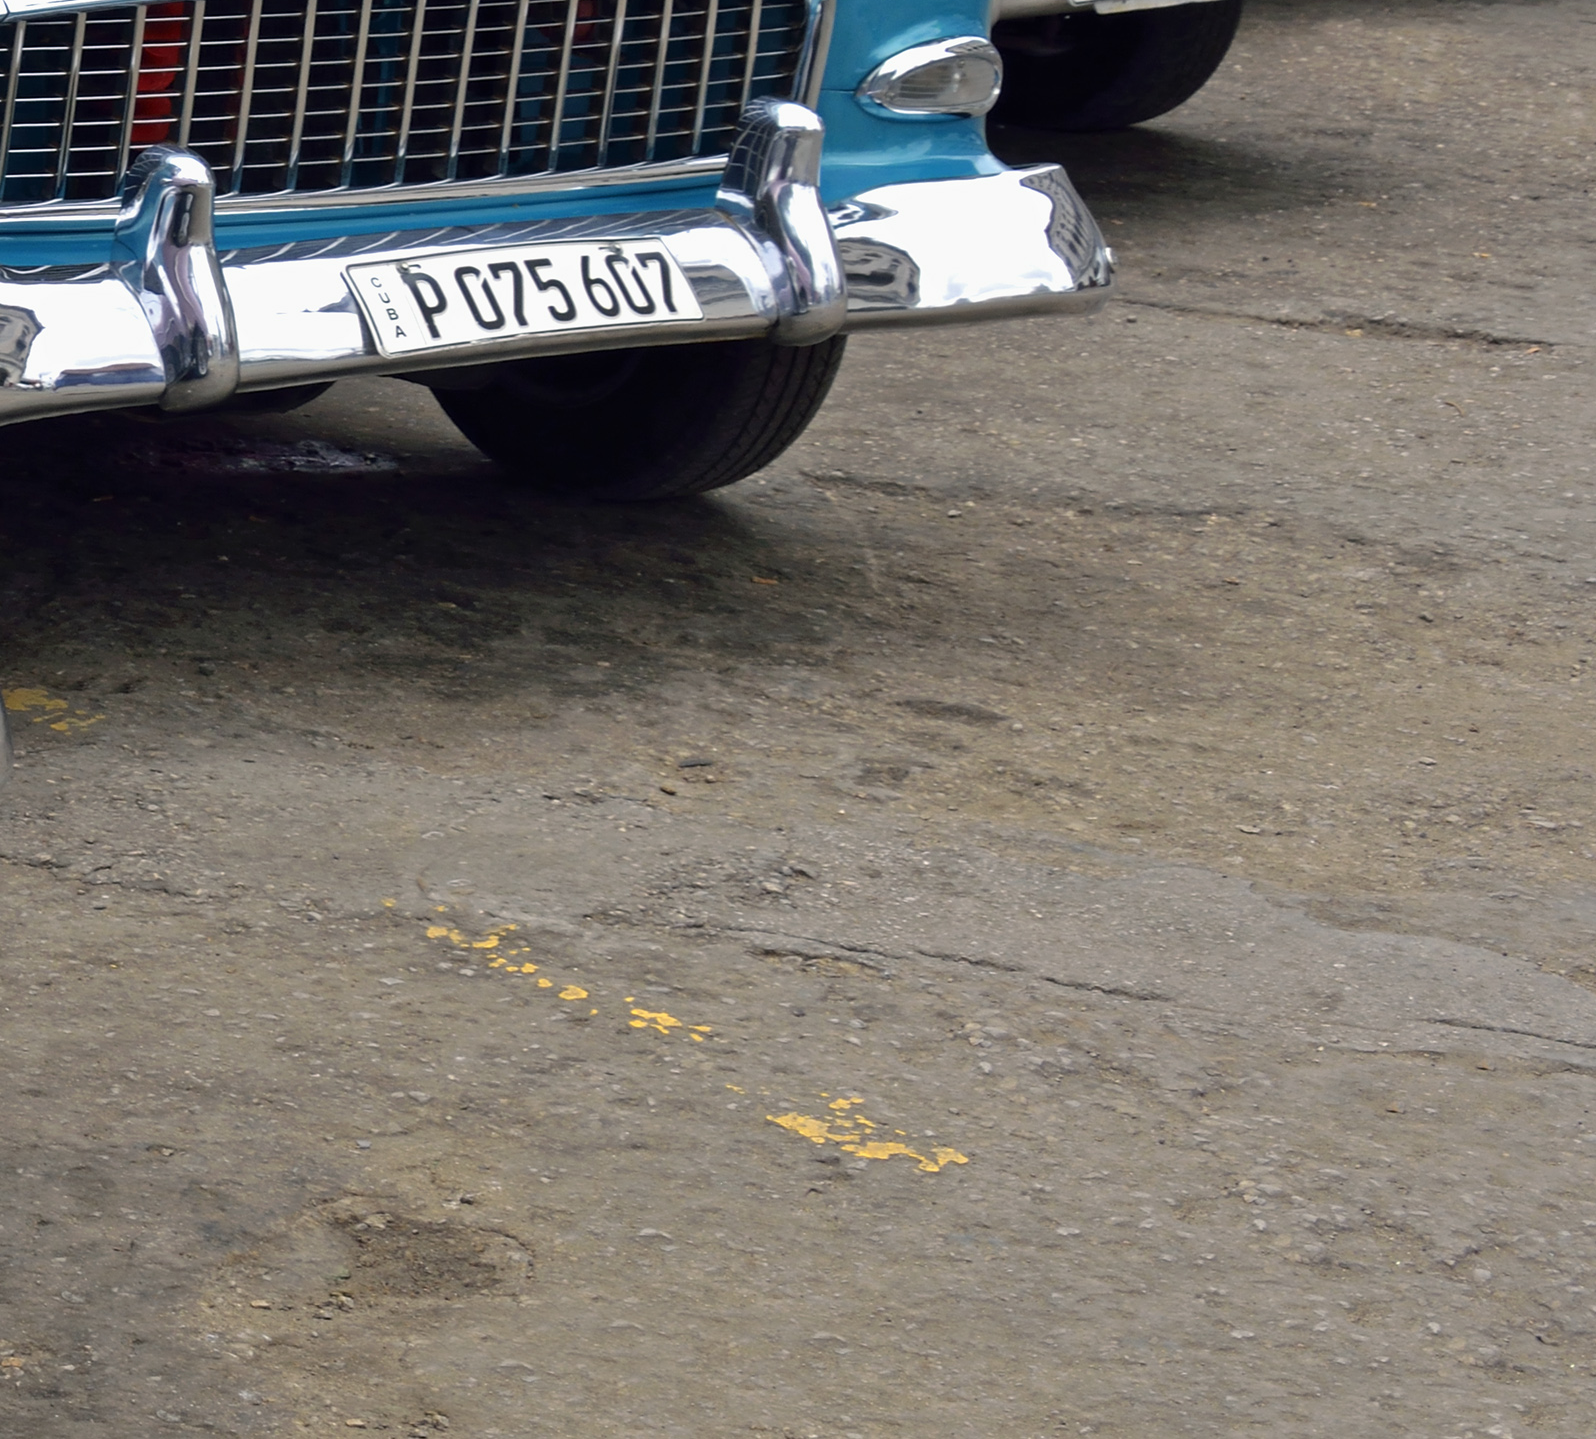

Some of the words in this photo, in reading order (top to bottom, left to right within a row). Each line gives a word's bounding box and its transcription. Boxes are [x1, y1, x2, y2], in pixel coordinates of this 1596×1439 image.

[370, 277, 407, 338] CUBA
[403, 271, 447, 339] P
[454, 259, 577, 331] 075
[581, 251, 677, 317] 607
